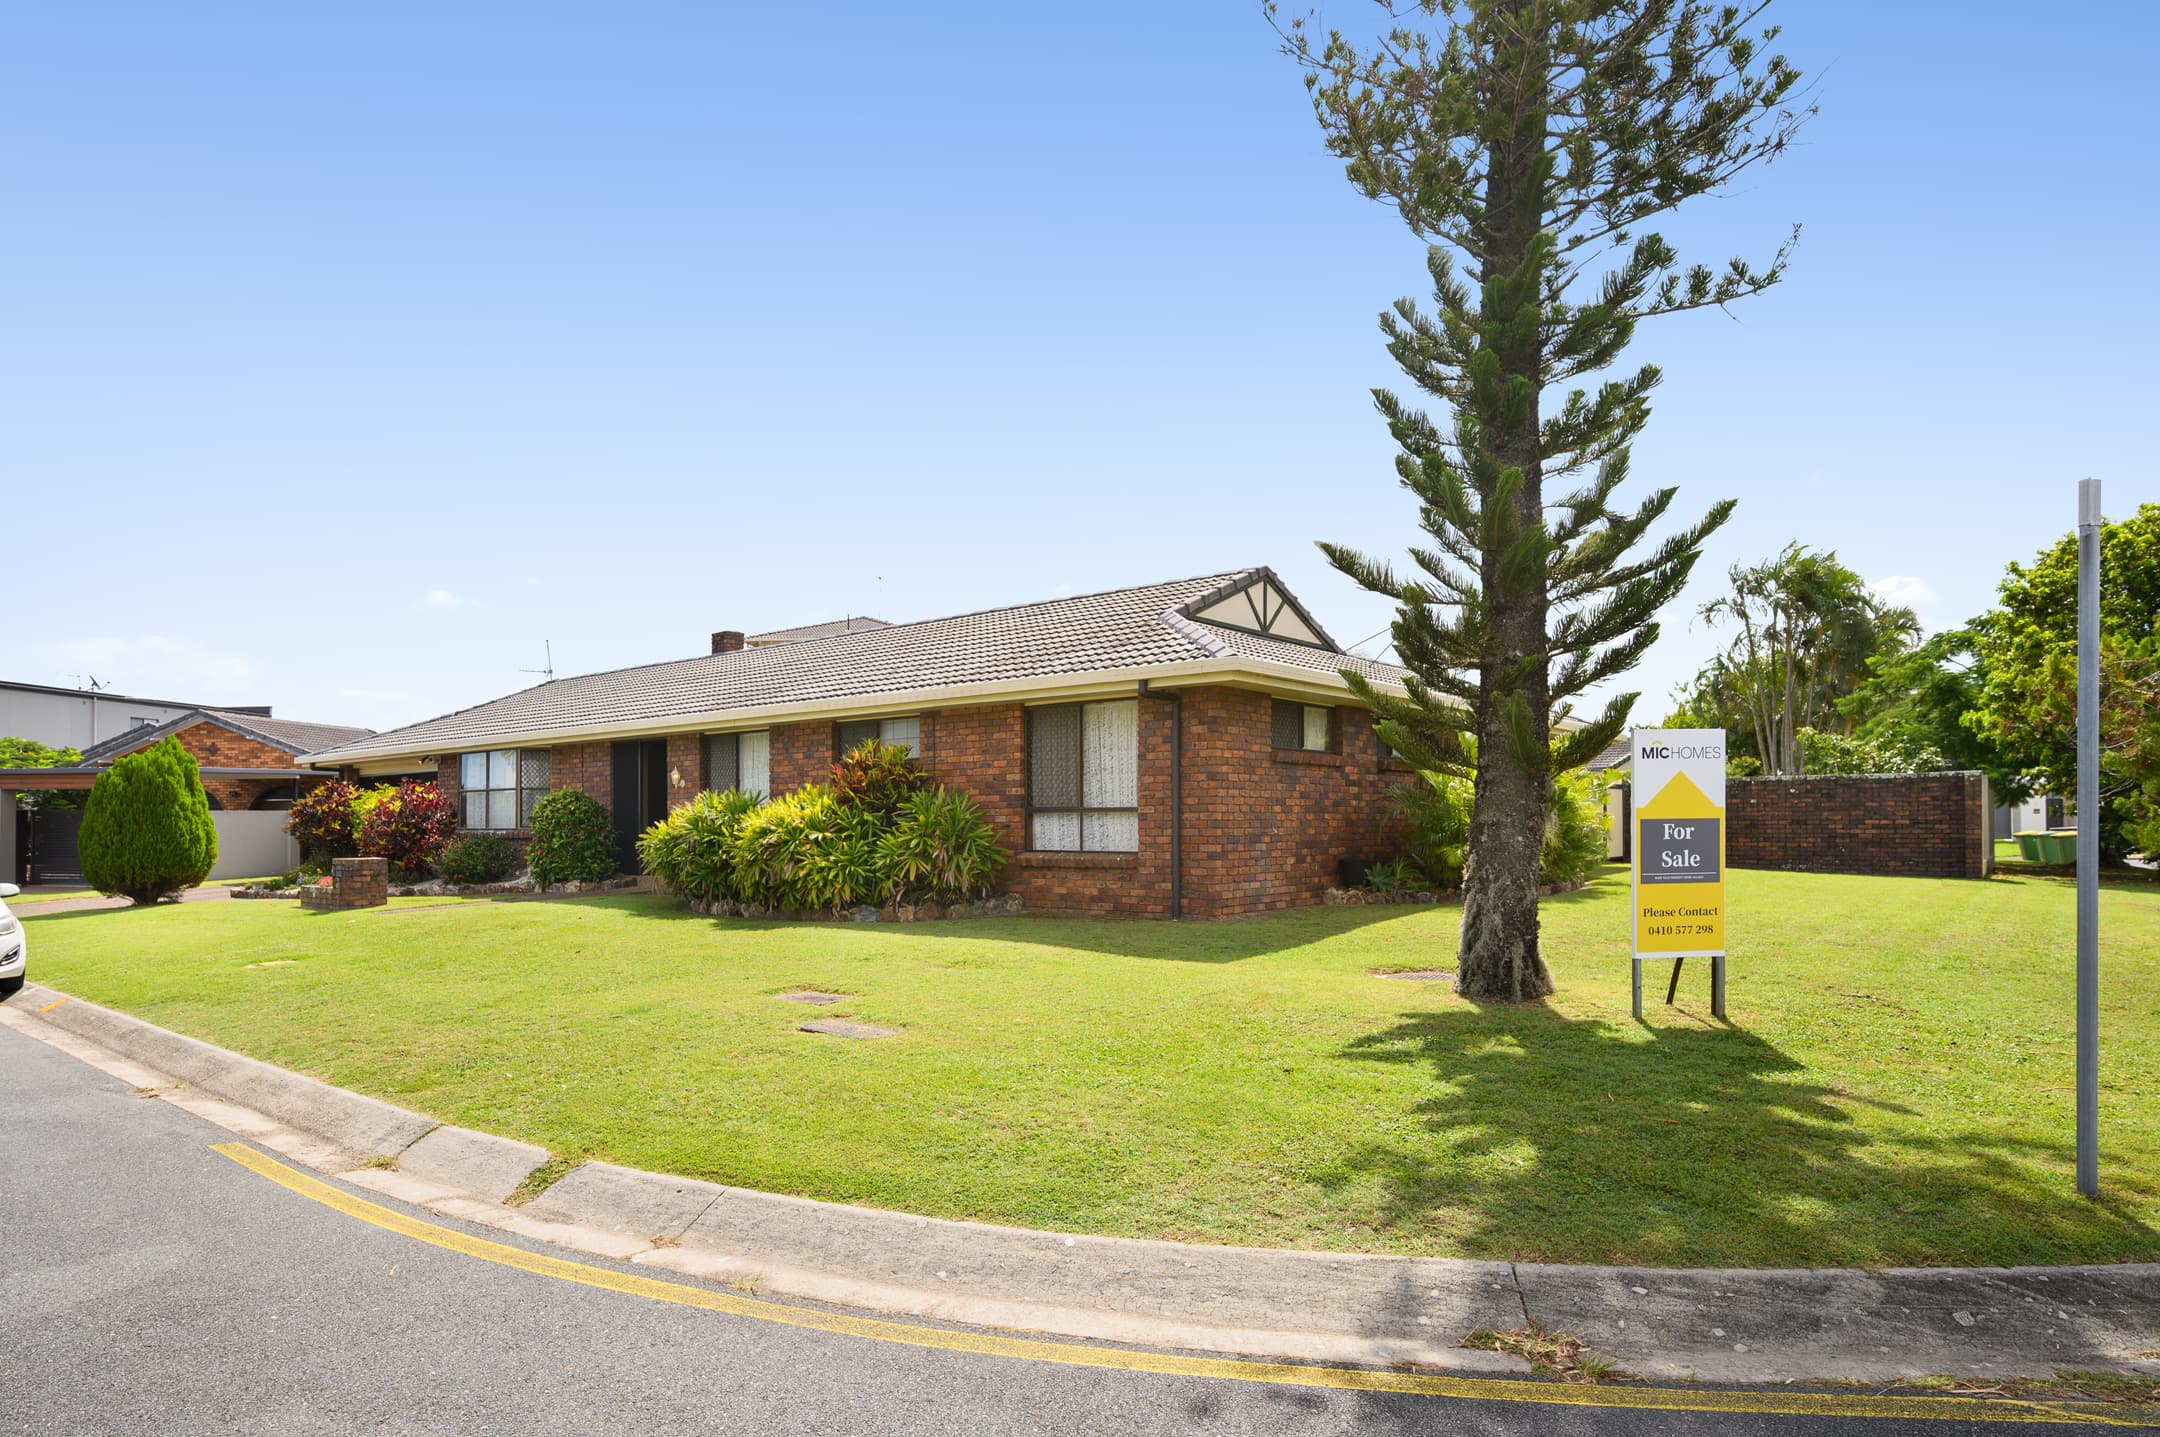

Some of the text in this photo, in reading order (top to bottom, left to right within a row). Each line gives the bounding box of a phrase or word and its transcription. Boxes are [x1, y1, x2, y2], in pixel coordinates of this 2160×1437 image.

[1663, 823, 1696, 840] For
[1661, 849, 1701, 868] Sale
[1643, 906, 1719, 918] Please Contact
[1648, 924, 1714, 936] 0410 577 298
